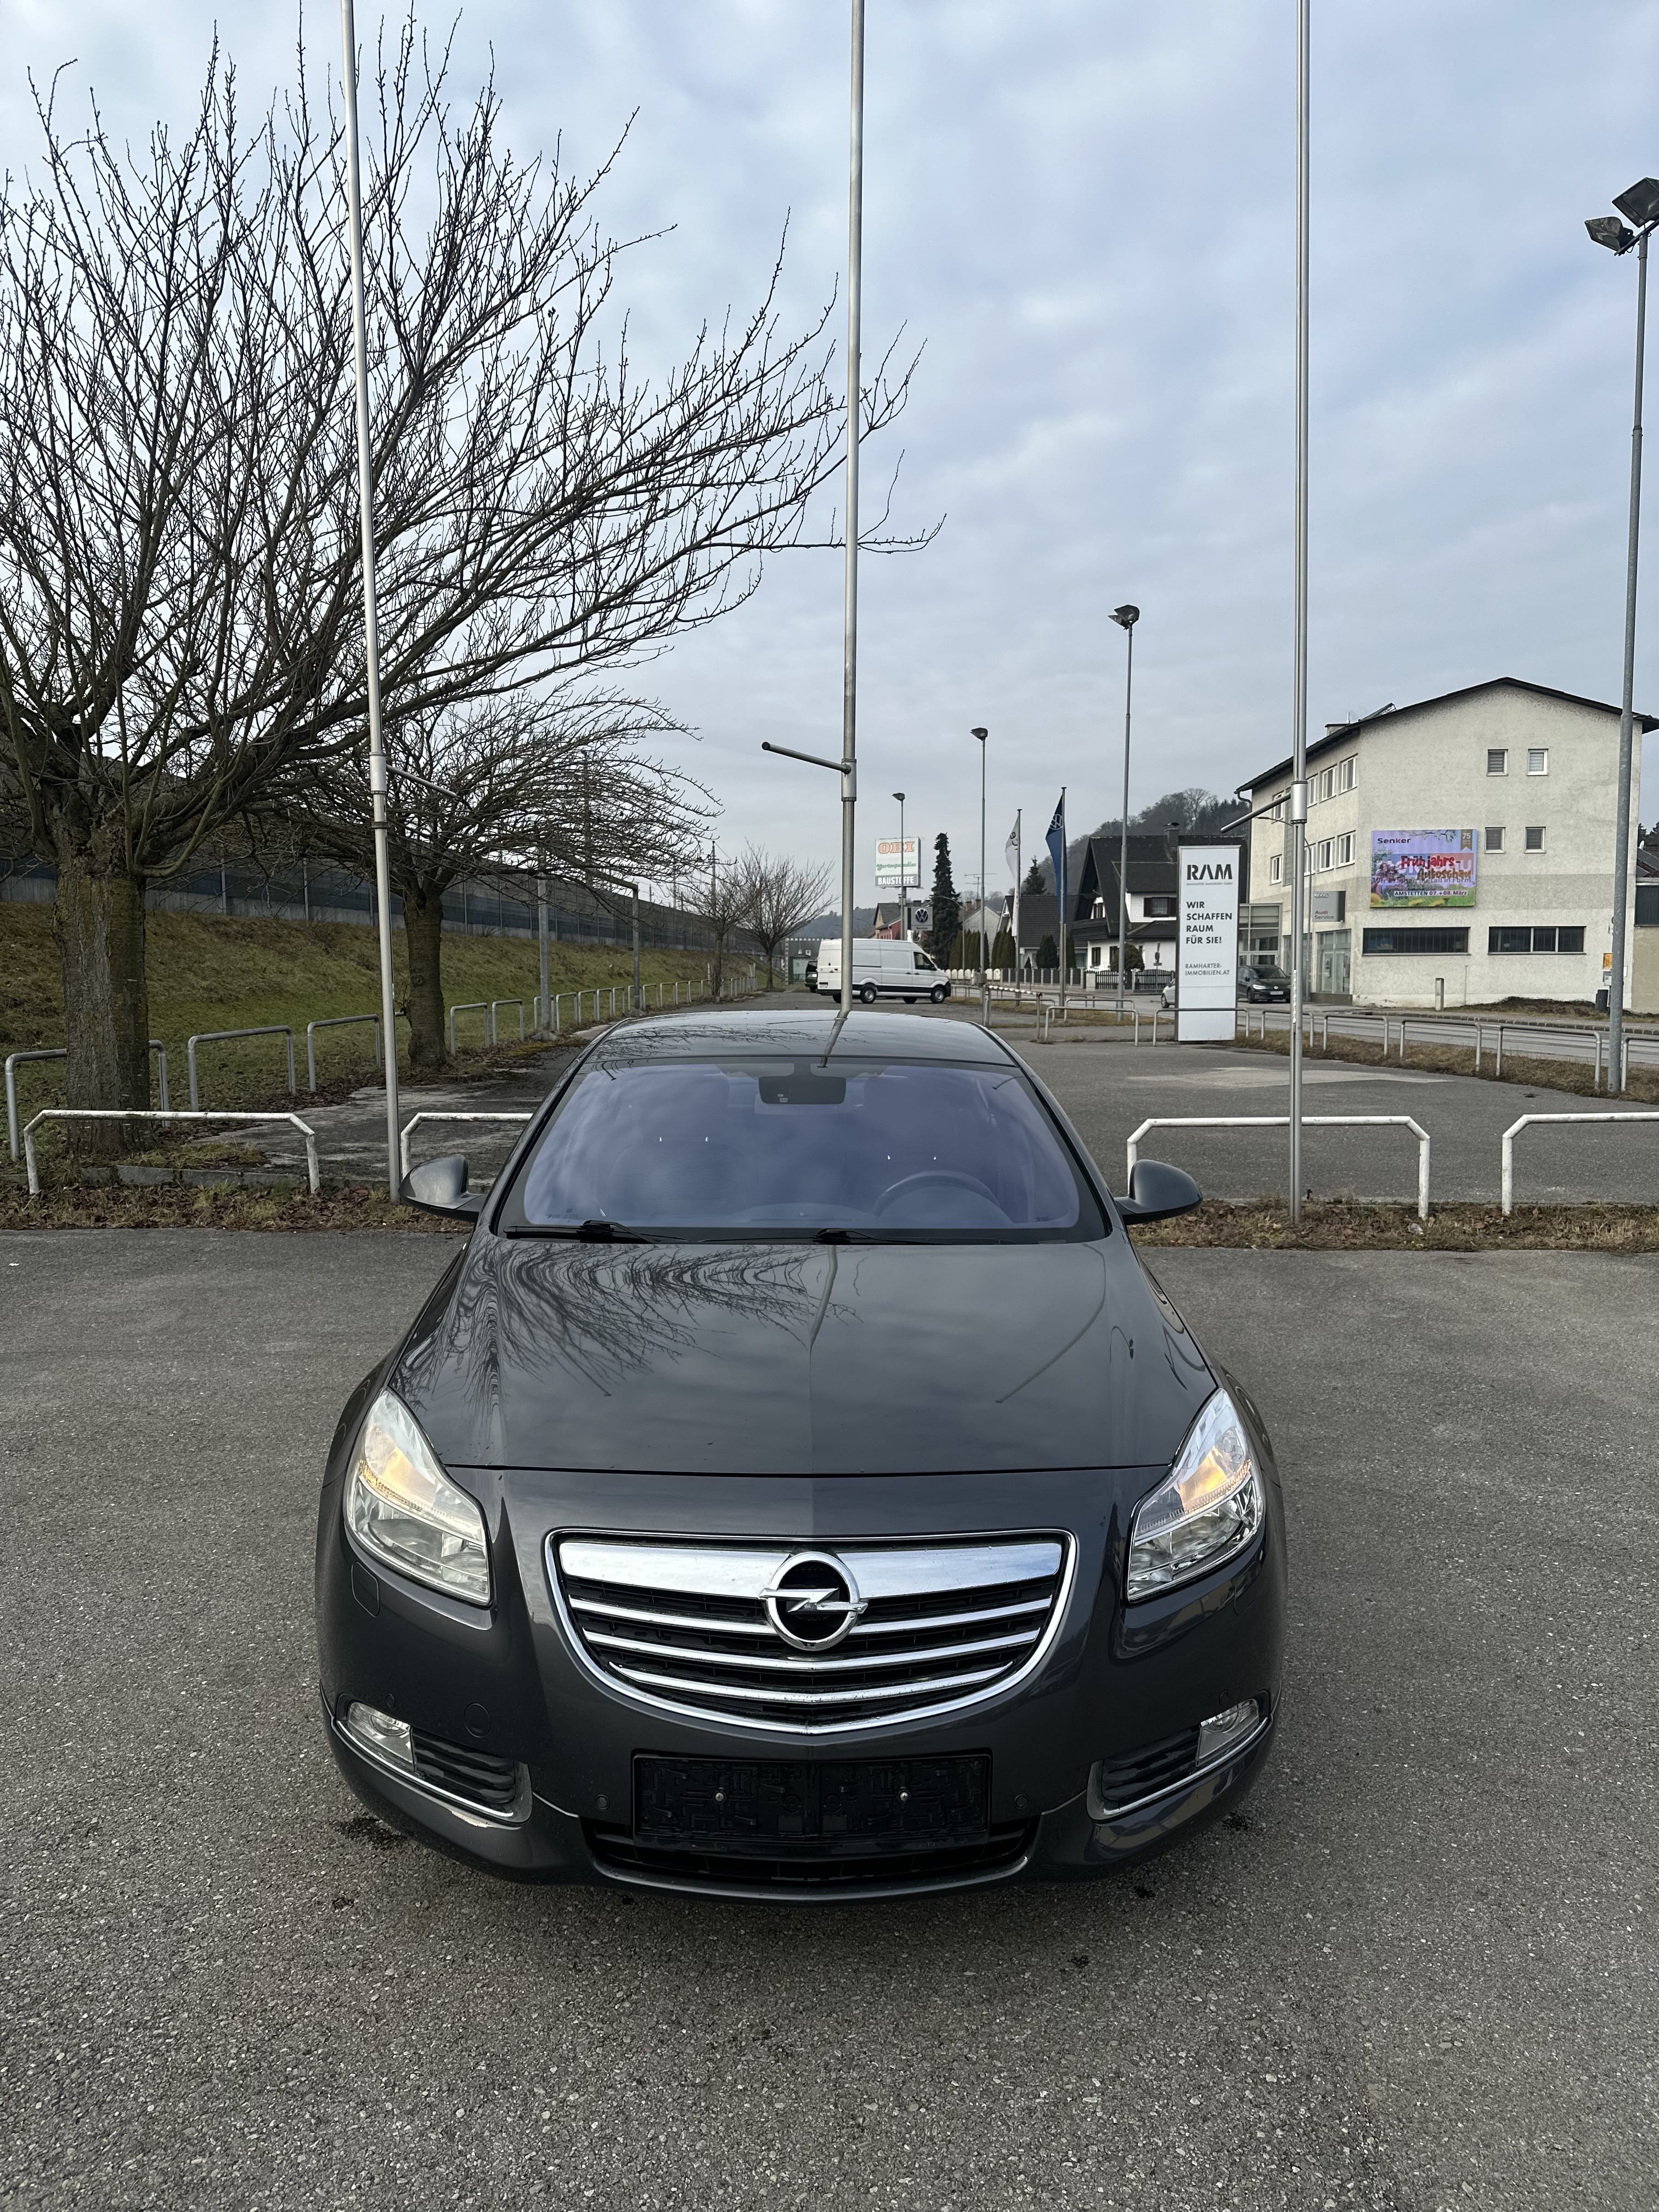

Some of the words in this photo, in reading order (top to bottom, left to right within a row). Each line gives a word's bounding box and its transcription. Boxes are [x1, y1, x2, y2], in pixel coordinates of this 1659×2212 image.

[878, 842, 915, 854] OBI
[1187, 864, 1233, 881] RAM
[1186, 935, 1203, 944] FÜR
